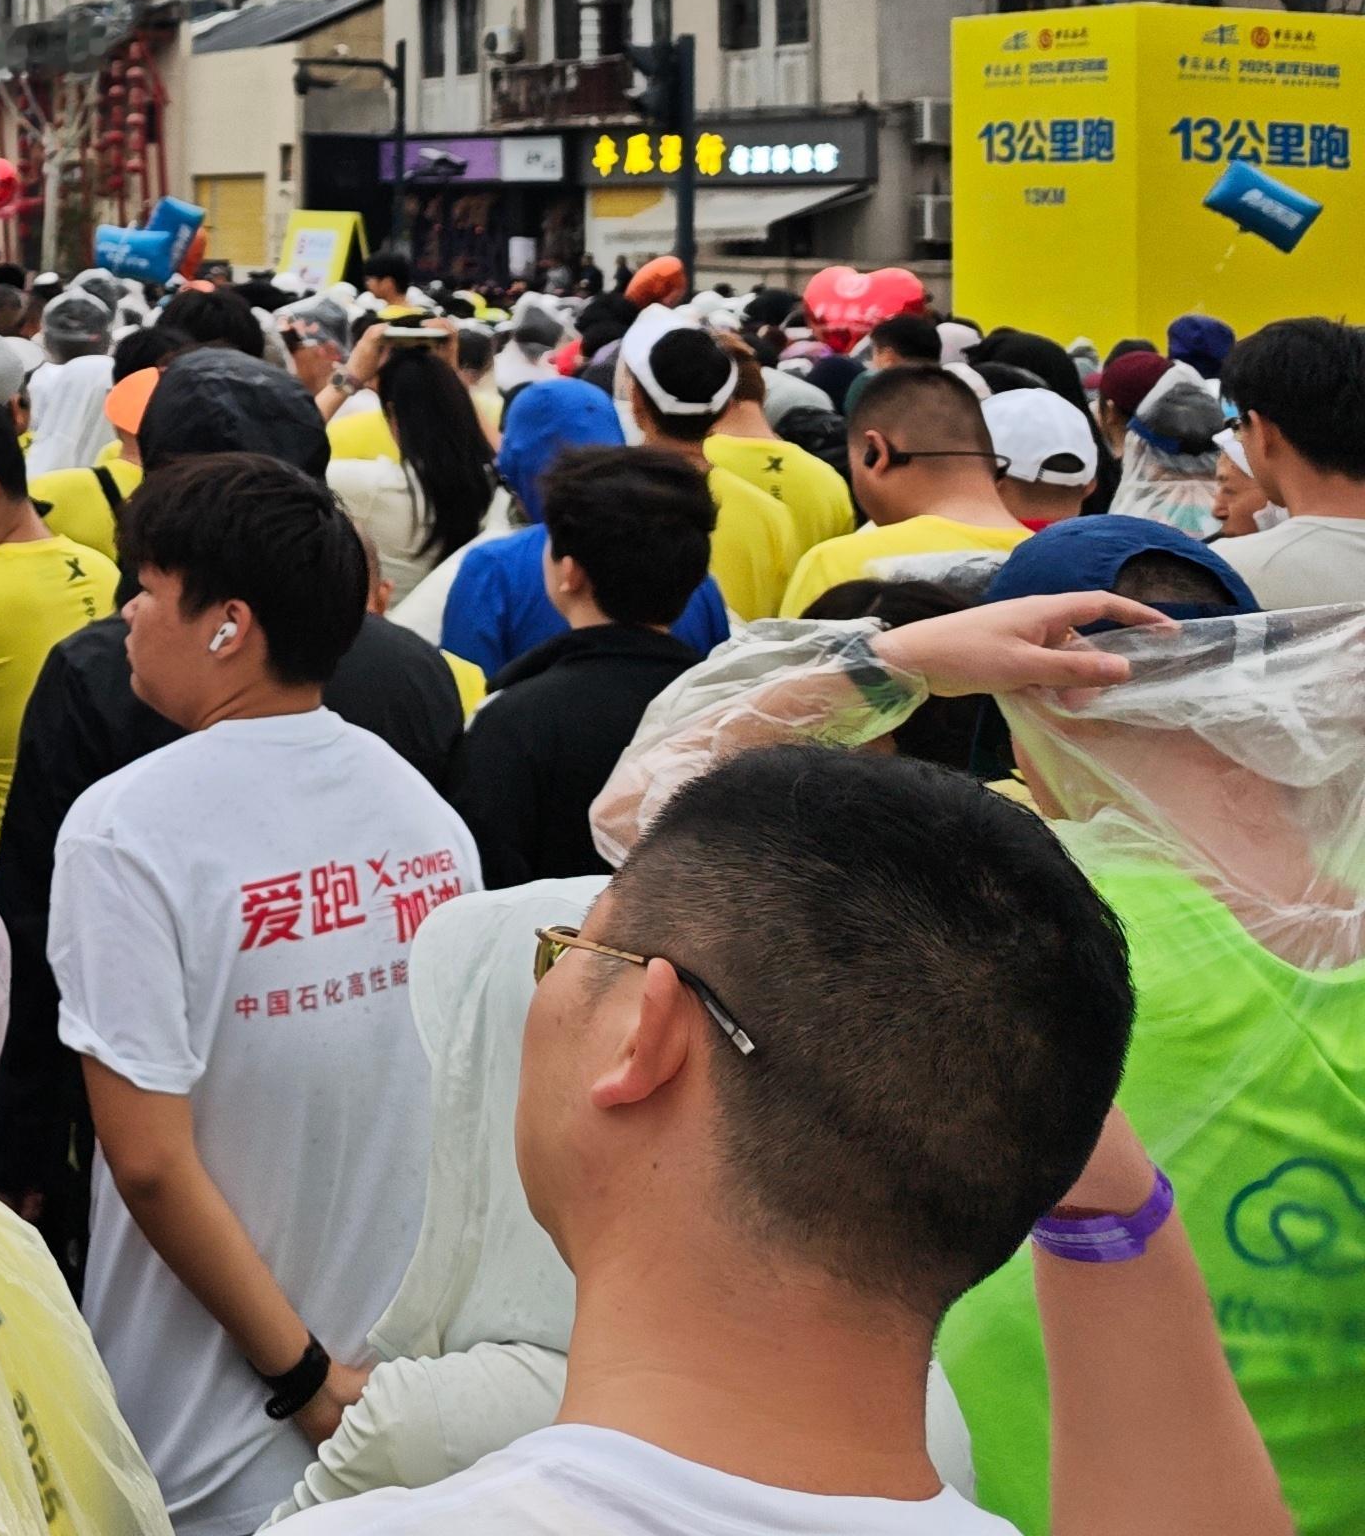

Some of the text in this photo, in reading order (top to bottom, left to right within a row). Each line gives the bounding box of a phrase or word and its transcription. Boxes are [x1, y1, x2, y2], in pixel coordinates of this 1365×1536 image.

[978, 117, 1115, 163] 13公里跑
[1170, 116, 1351, 169] 13公里跑
[238, 859, 368, 952] 爱跑
